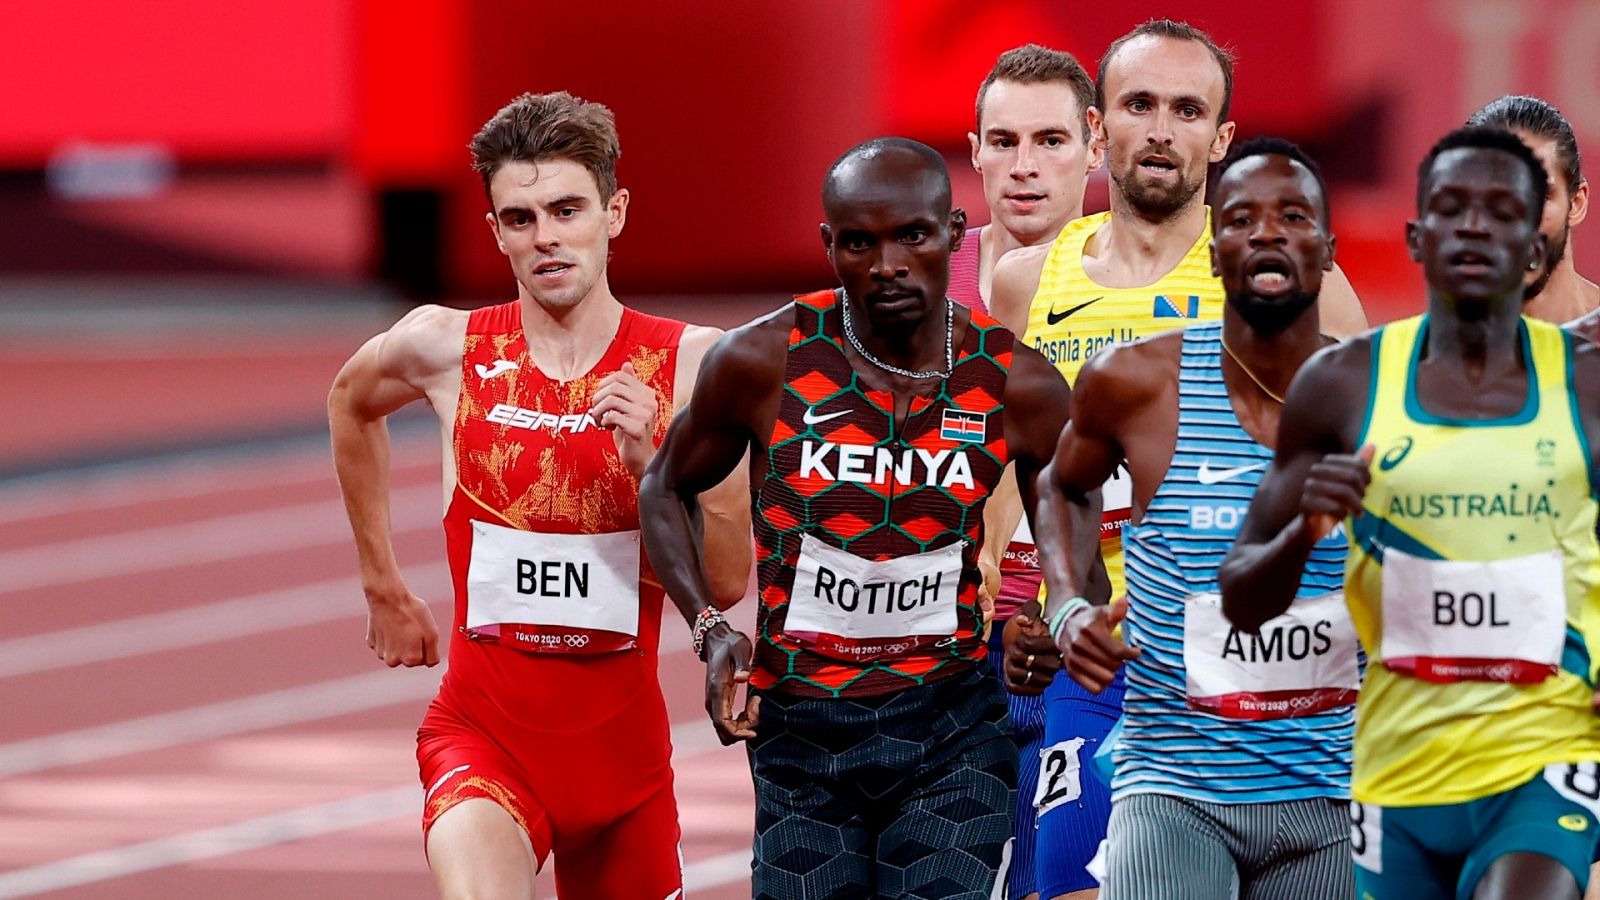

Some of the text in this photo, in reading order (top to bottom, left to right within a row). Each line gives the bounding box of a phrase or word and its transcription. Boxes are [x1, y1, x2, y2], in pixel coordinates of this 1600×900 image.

[486, 403, 598, 434] ESPA
[800, 440, 975, 490] KENYA
[1388, 494, 1552, 519] AUSTRALIA
[516, 558, 589, 598] BEN
[814, 566, 943, 615] ROTICH
[1432, 590, 1510, 628] BOL
[515, 631, 561, 644] TOKYO 2020
[861, 646, 882, 655] 2020
[1221, 619, 1332, 664] AMOS
[1239, 699, 1289, 711] TOKYO 2020
[1039, 749, 1068, 806] 2
